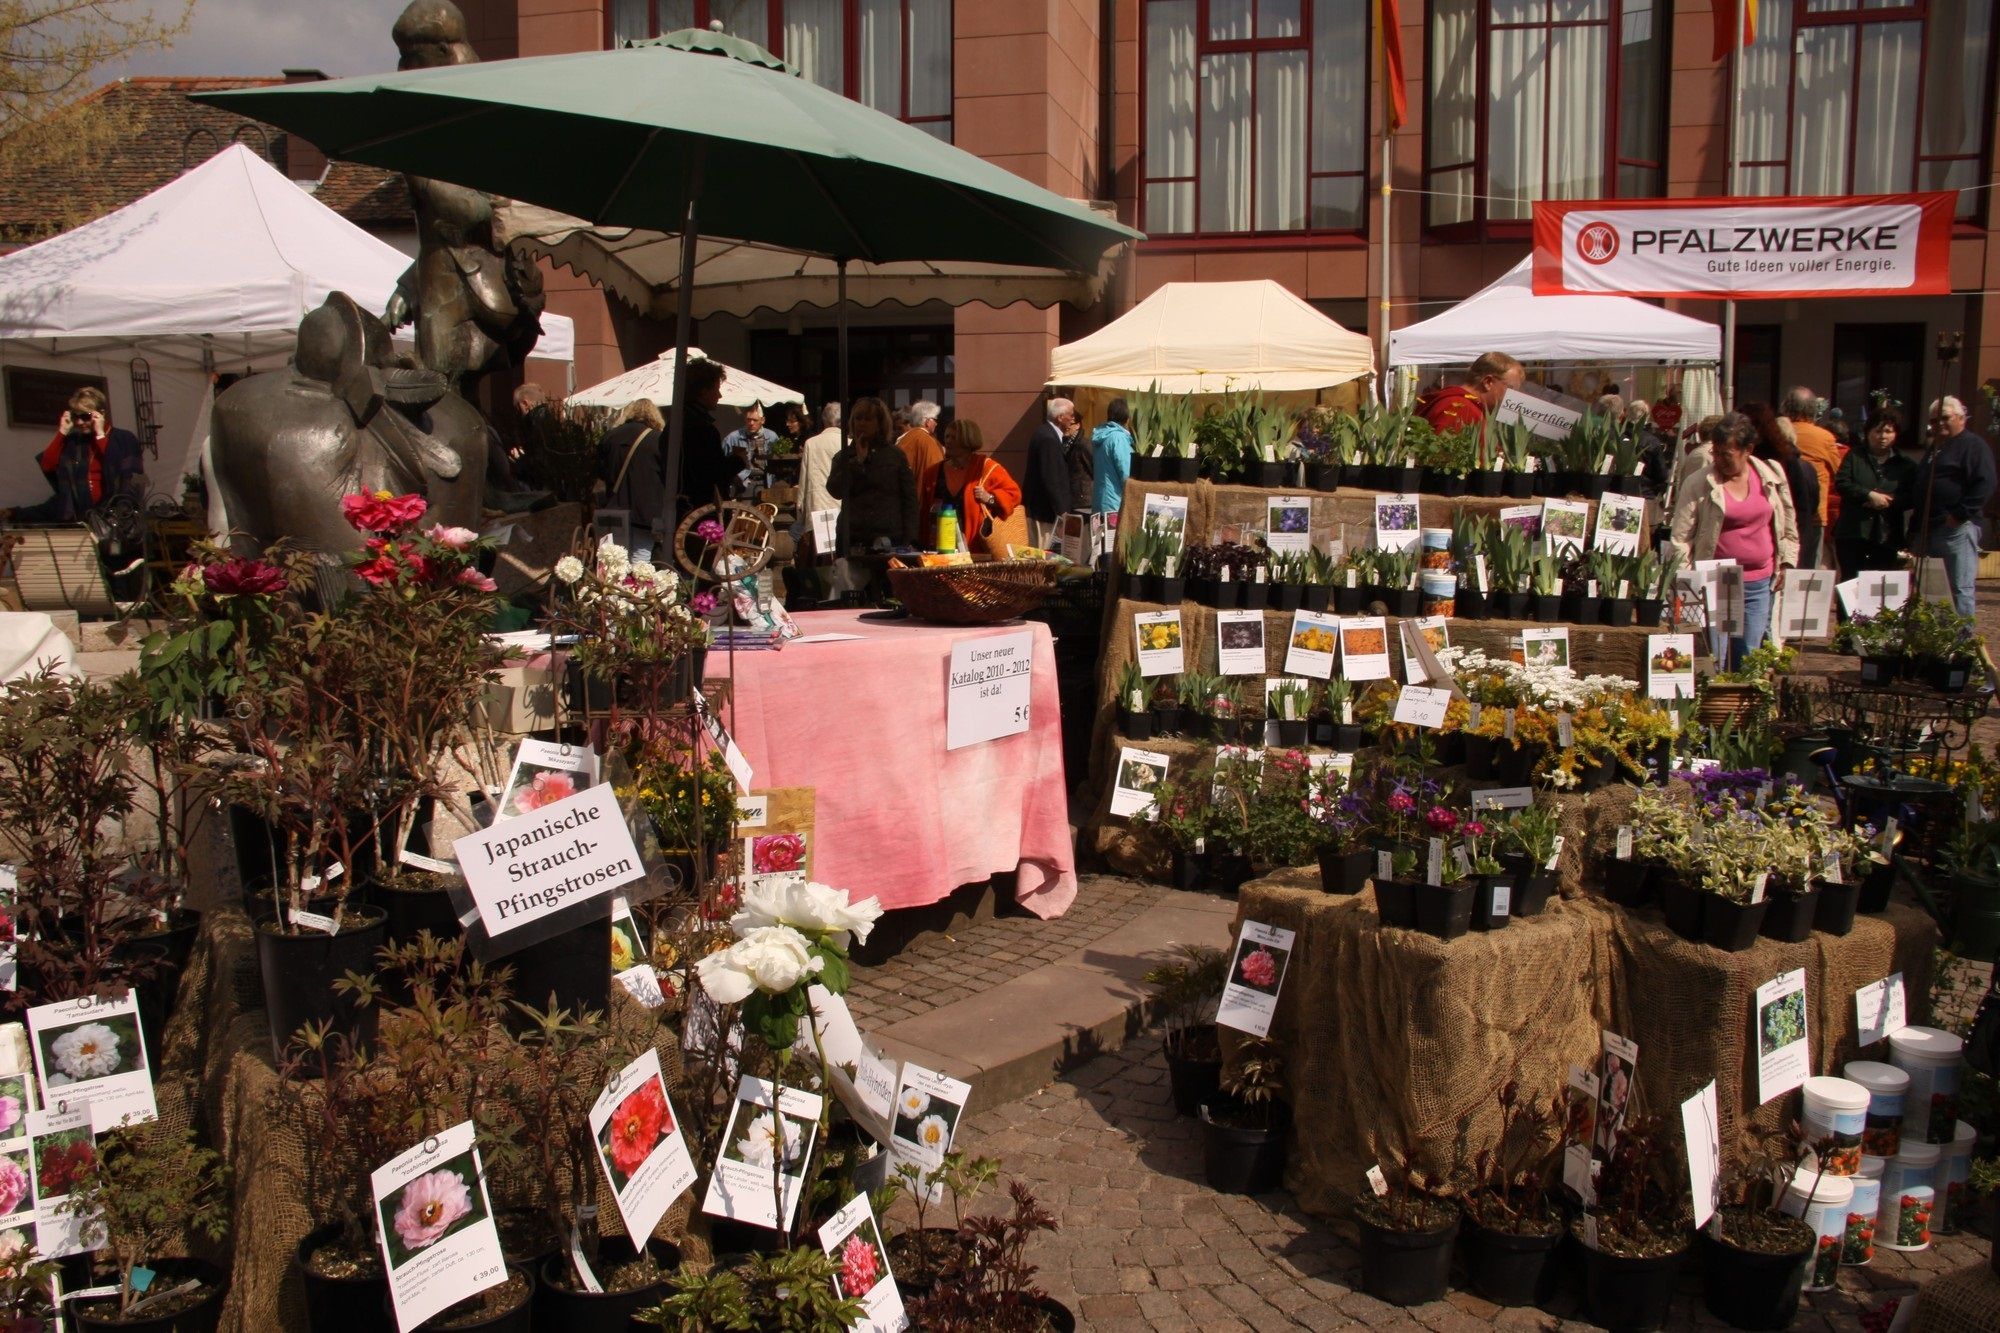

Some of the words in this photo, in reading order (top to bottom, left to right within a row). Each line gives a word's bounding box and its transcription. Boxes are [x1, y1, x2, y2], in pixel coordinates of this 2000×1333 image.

[1632, 225, 1900, 255] PFALZWERKE
[1707, 259, 1740, 273] Gute
[1745, 259, 1783, 273] Ideen
[1789, 259, 1829, 273] voller
[1835, 258, 1896, 275] Energie.
[970, 651, 992, 662] Unser
[994, 647, 1015, 658] neuer
[951, 669, 985, 686] Katalog
[986, 664, 1005, 679] 2010
[1012, 659, 1030, 674] 2012
[980, 687, 989, 698] ist
[991, 684, 1002, 696] da!
[1014, 707, 1021, 722] 5
[1023, 705, 1030, 720] €
[482, 806, 601, 865] Japanische
[507, 839, 598, 883] Strauch-
[494, 858, 633, 919] Pfingstrosen
[391, 1156, 413, 1175] Paeonia
[395, 1247, 447, 1282] Strauch-Pfingstrose
[473, 1274, 479, 1282] €
[480, 1265, 500, 1280] 39,00
